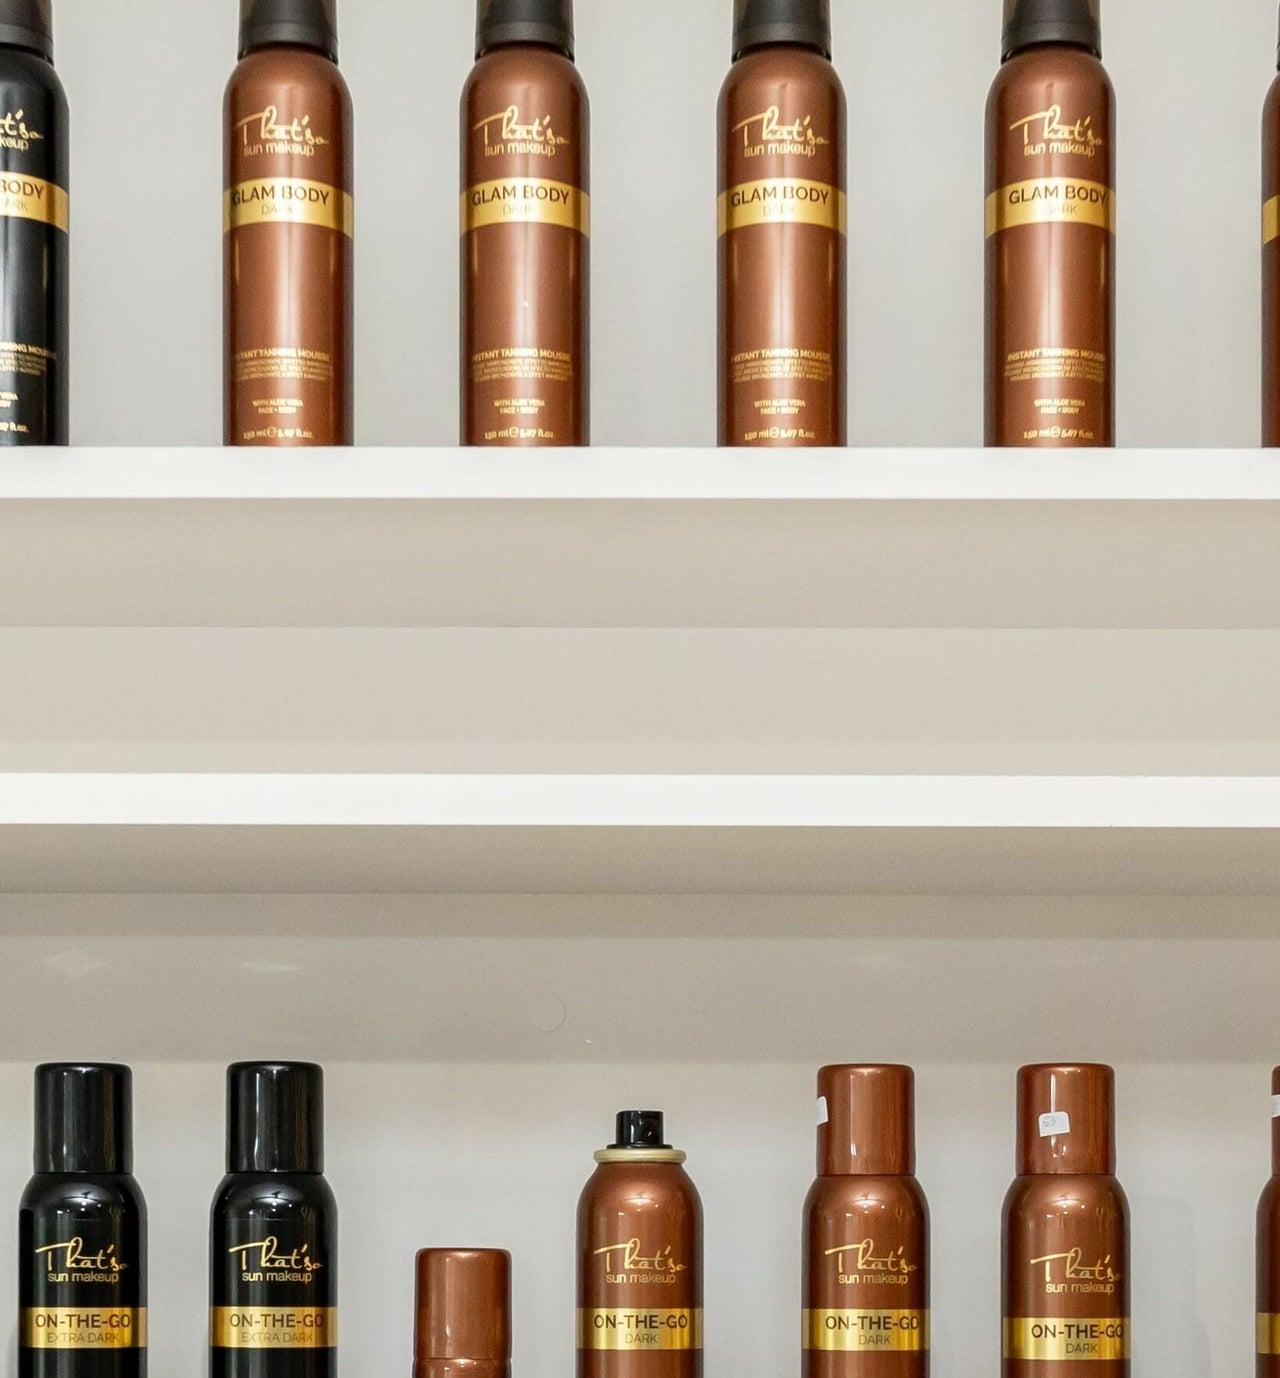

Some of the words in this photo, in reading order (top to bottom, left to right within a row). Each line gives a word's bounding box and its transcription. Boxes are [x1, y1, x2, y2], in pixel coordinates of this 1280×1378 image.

[233, 186, 275, 206] GLAM
[281, 185, 329, 205] BODY
[473, 186, 516, 206] GLAM
[523, 185, 569, 204] BODY
[731, 187, 776, 207] GLAM
[783, 187, 829, 205] BODY
[1009, 185, 1059, 205] GLAM
[1065, 185, 1107, 205] BODY
[47, 1272, 69, 1282] sun
[72, 1271, 119, 1283] makeup
[242, 1271, 263, 1281] sun
[266, 1270, 312, 1283] makeup
[606, 1273, 627, 1284] sun
[630, 1273, 676, 1284] makeup
[838, 1274, 859, 1284] sun
[863, 1273, 908, 1286] makeup
[1046, 1283, 1067, 1293] sun
[1071, 1282, 1115, 1295] makeup
[35, 1313, 130, 1329] ON-THE-GO
[229, 1313, 323, 1329] ON-THE-GO
[594, 1315, 688, 1329] ON-THE-GO
[825, 1315, 919, 1331] ON-THE-GO
[47, 1332, 84, 1343] EXTRA
[88, 1332, 119, 1344] DARK
[241, 1331, 278, 1343] EXTRA
[282, 1331, 314, 1343] DARK
[1032, 1324, 1124, 1339] ON-THE-GO
[625, 1333, 658, 1344] DARK
[858, 1335, 891, 1345] DARK
[1066, 1343, 1099, 1354] DARK
